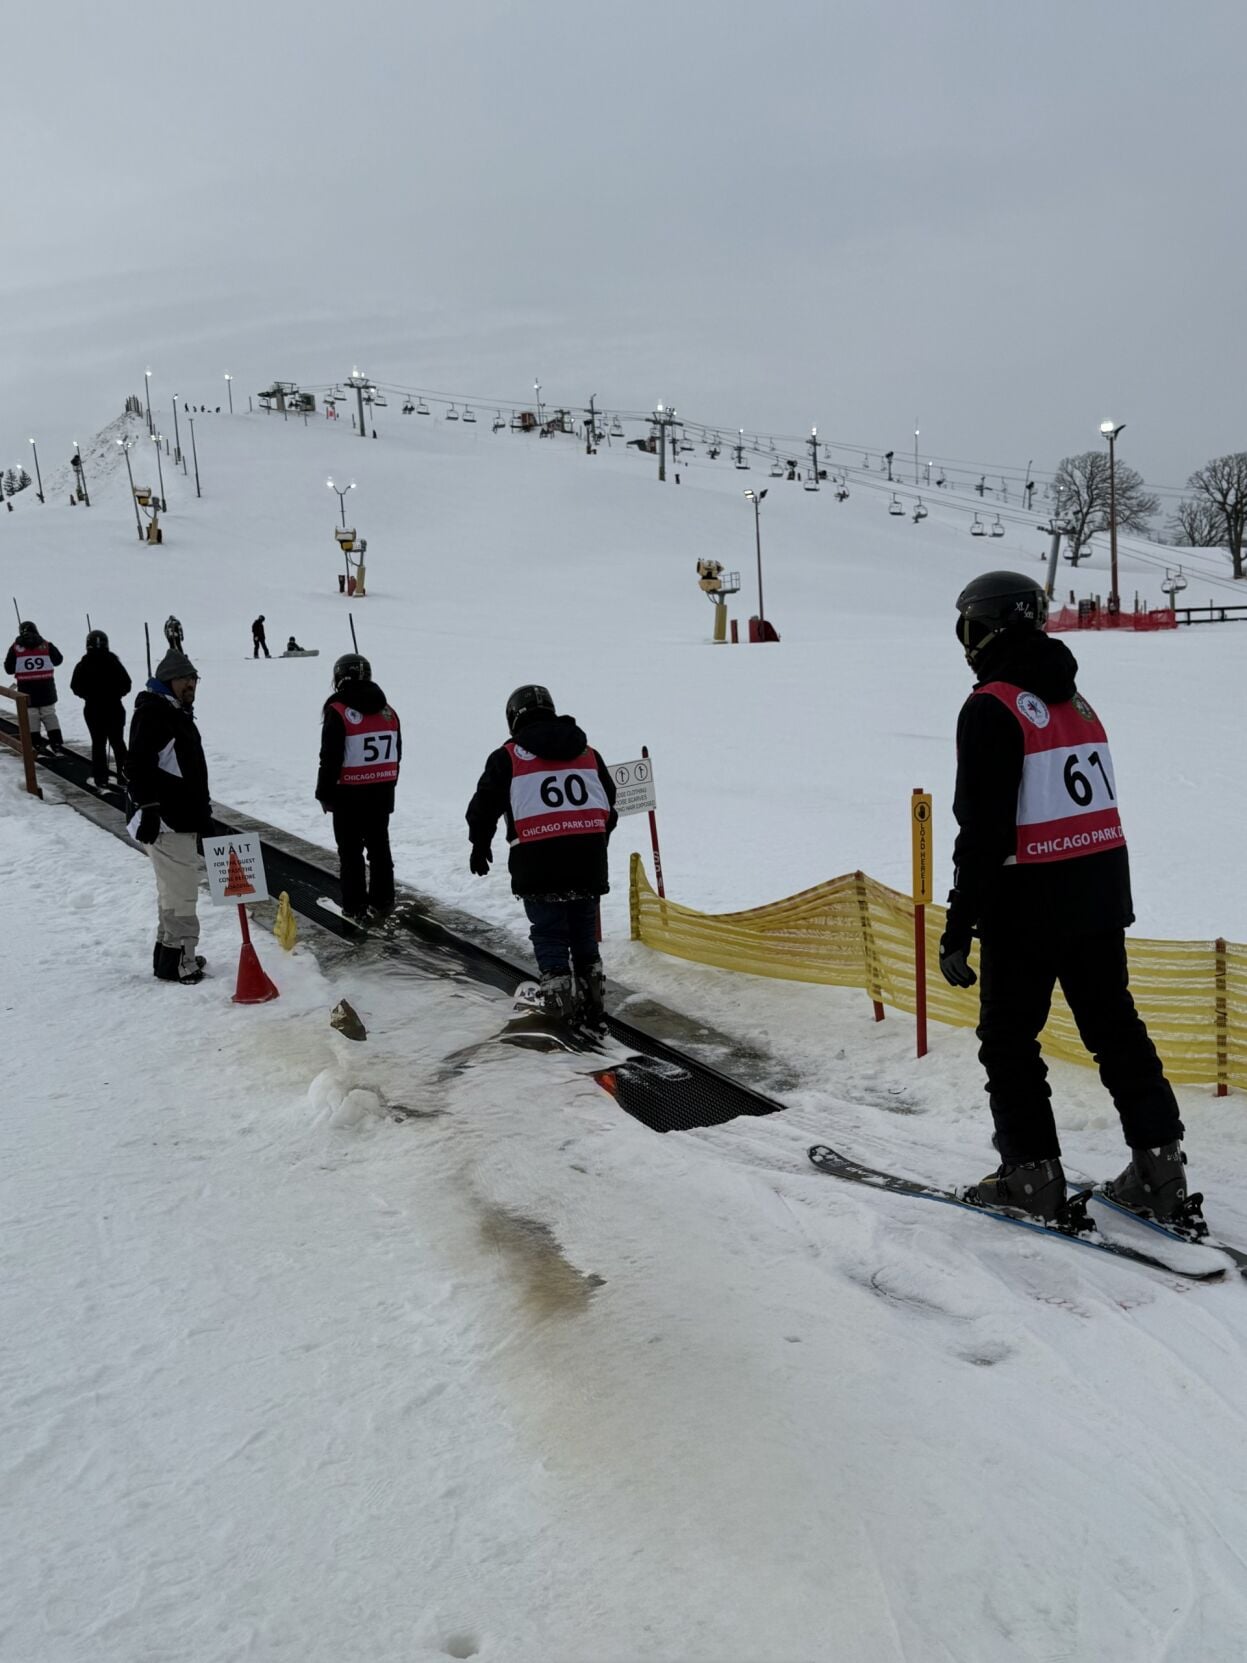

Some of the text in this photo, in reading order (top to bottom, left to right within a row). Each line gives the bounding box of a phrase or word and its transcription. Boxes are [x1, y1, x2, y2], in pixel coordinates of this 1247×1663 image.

[24, 657, 45, 670] 69
[363, 734, 392, 762] 57
[343, 772, 376, 781] CHICAGO
[1063, 751, 1114, 807] 61
[540, 774, 589, 808] 60
[522, 823, 561, 837] CHICAGO
[562, 820, 584, 830] PARK
[213, 843, 251, 856] WAIT
[1026, 832, 1090, 855] CHICAGO
[1091, 827, 1118, 843] PARK
